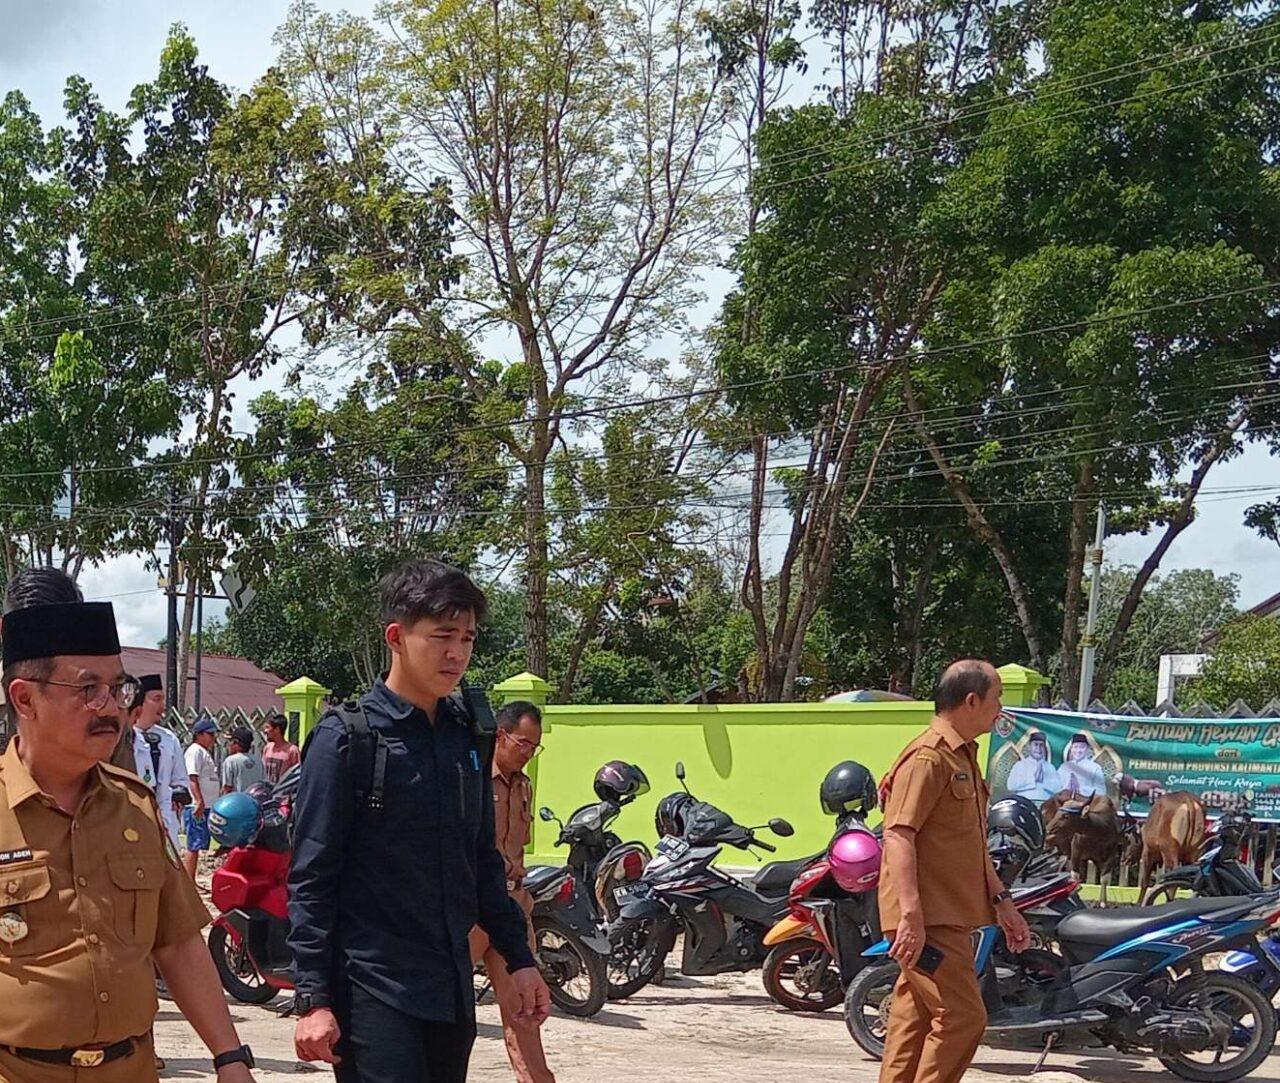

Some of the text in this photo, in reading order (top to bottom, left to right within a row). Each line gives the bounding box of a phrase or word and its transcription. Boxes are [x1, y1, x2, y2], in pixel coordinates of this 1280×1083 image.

[1165, 775, 1262, 789] Selamat Hari Raya
